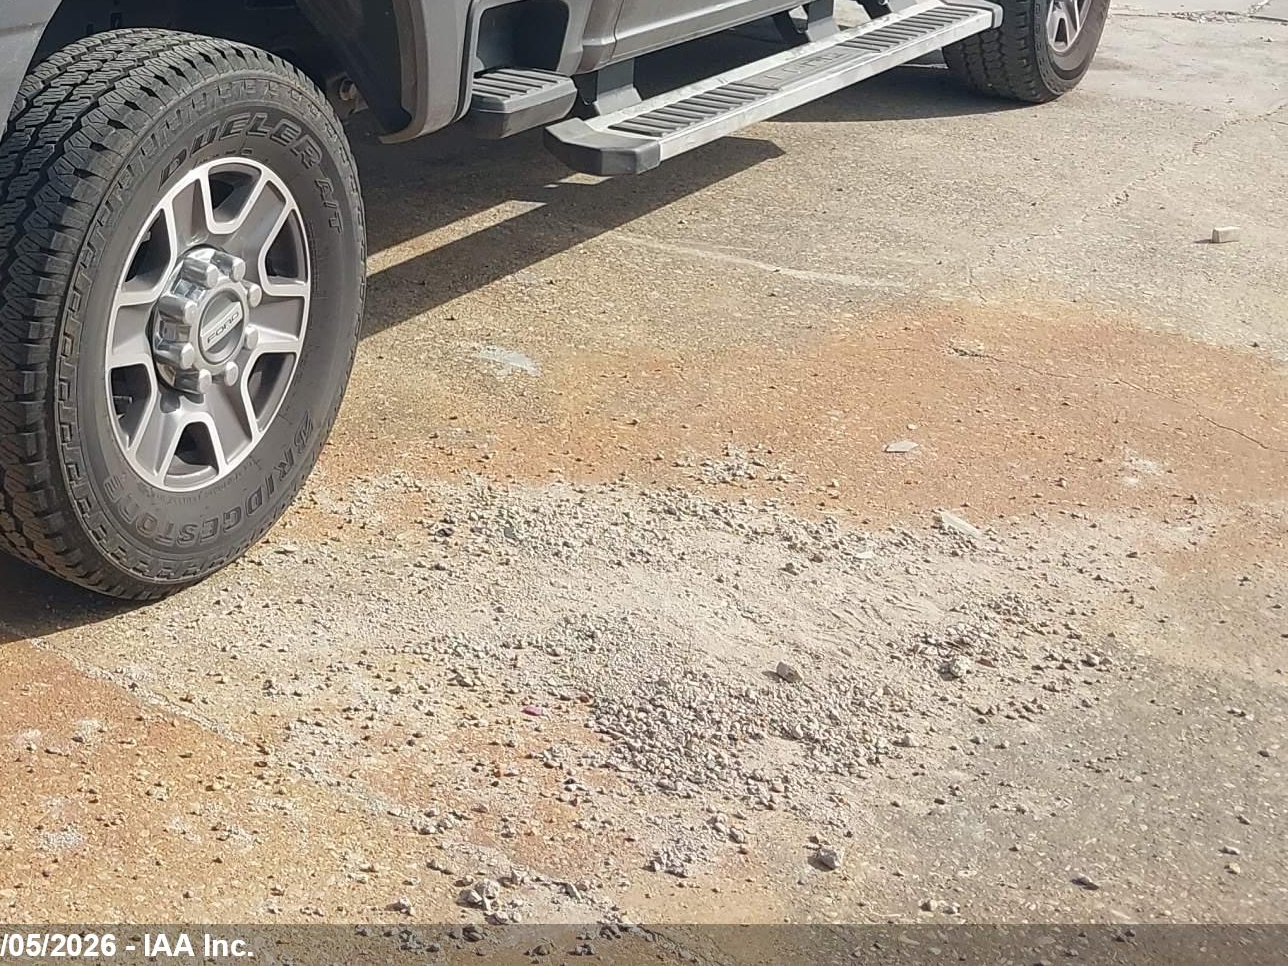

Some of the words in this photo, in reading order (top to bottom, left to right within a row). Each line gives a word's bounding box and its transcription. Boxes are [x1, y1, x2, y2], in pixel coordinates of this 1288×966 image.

[159, 112, 323, 191] DUELER
[206, 311, 240, 344] FORD
[103, 409, 314, 547] BRIDGESTONE
